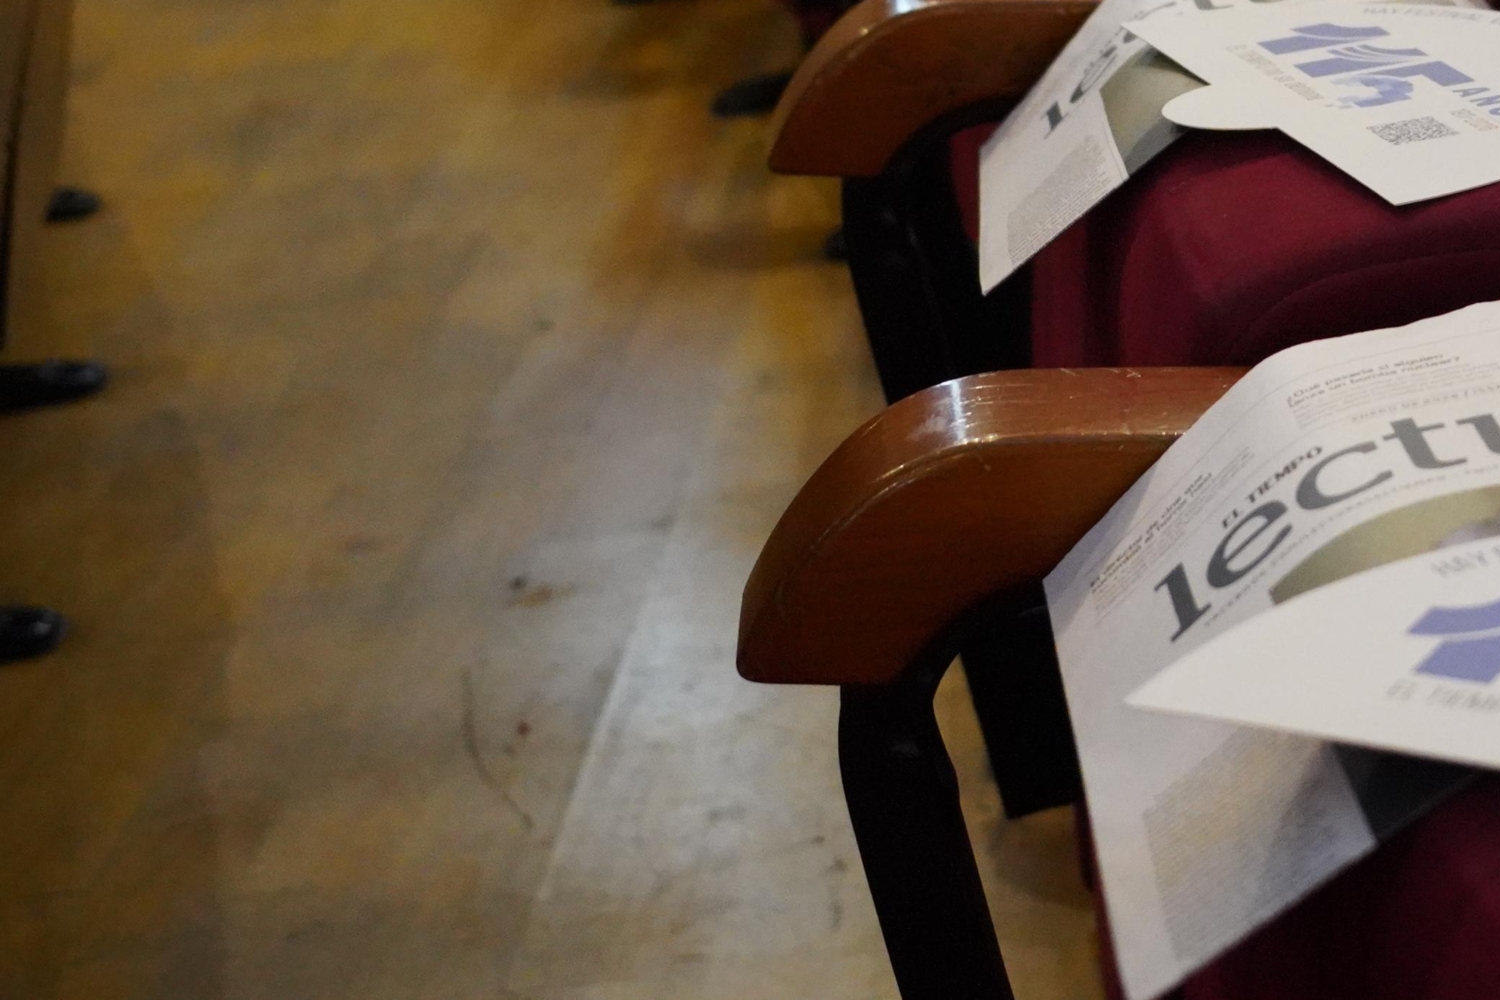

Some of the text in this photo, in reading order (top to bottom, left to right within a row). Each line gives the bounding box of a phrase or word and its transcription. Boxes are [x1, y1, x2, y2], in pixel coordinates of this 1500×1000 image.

[1257, 22, 1475, 108] 115
[1220, 508, 1241, 530] EL
[1245, 446, 1323, 503] TIEMPO
[1432, 550, 1488, 578] HAY
